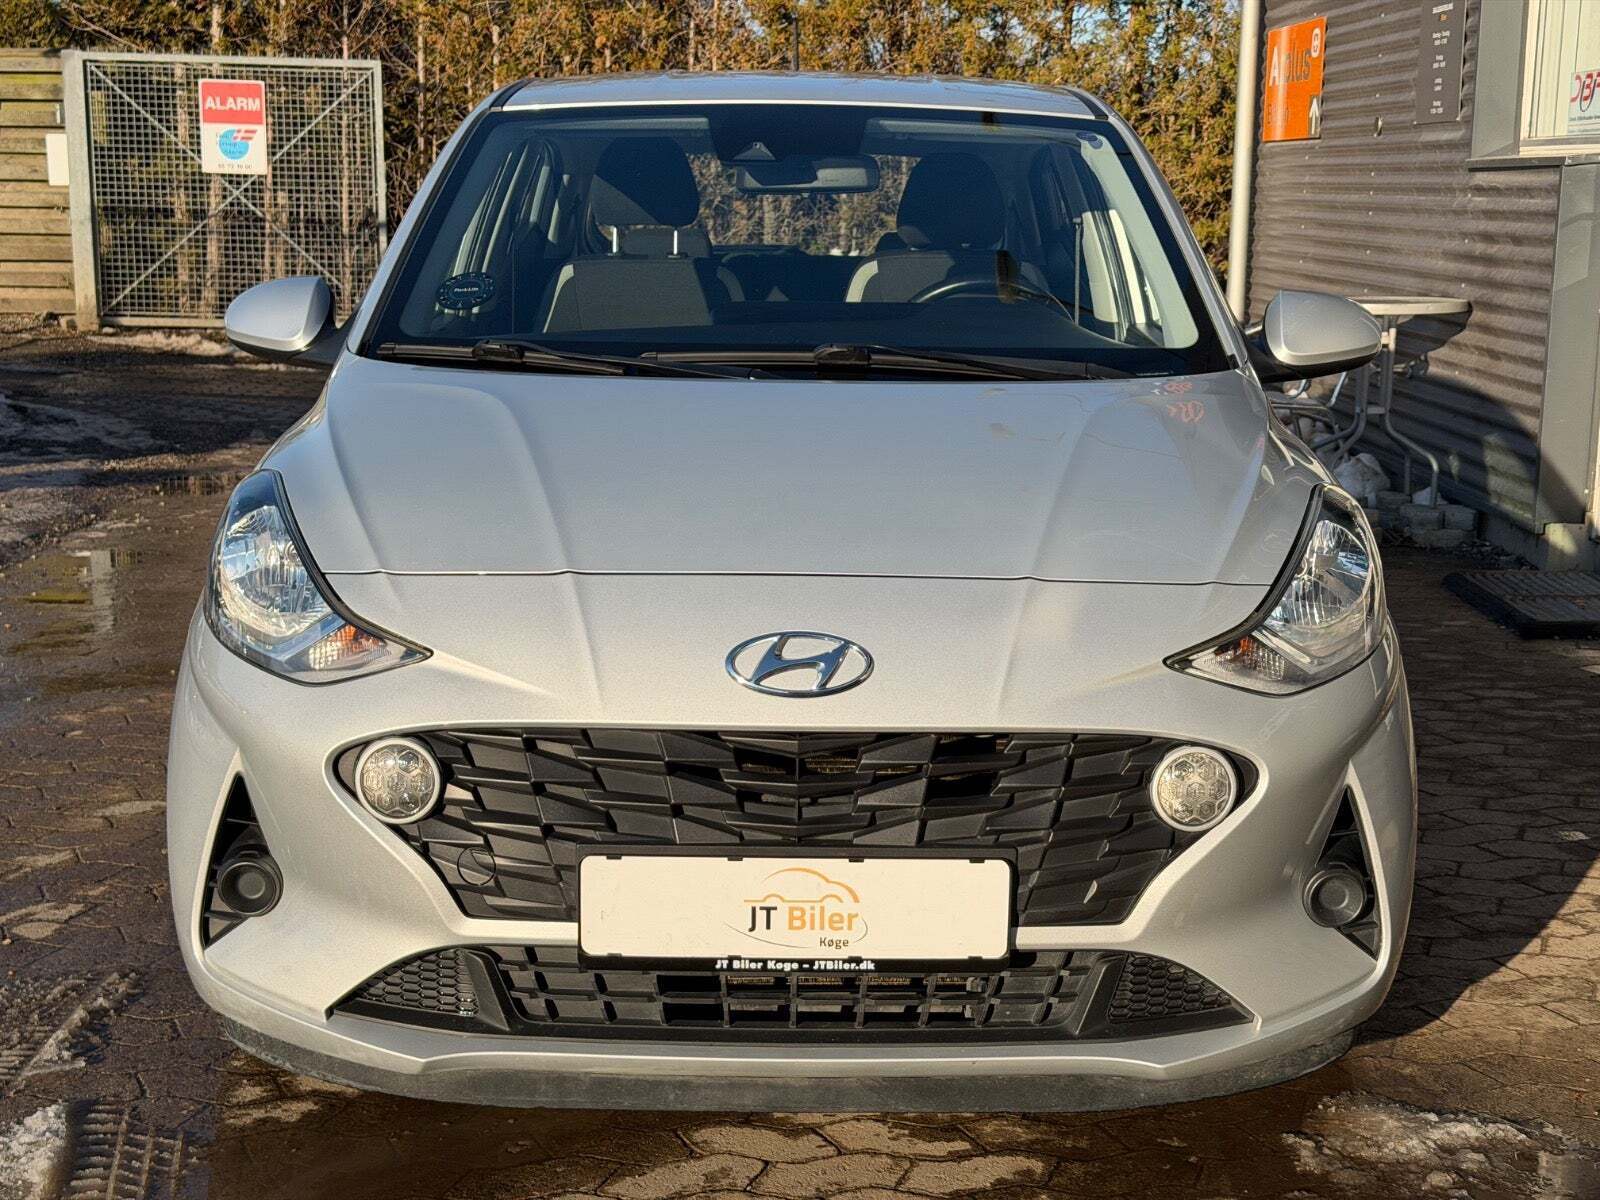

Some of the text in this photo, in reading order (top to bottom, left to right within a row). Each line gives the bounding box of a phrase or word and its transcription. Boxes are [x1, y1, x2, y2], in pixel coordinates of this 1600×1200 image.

[205, 95, 260, 112] ALARM
[748, 905, 859, 933] JT Biler
[819, 937, 849, 950] Køge
[715, 959, 729, 970] JT
[732, 959, 764, 970] Biler
[812, 959, 876, 971] JTBiler.dk
